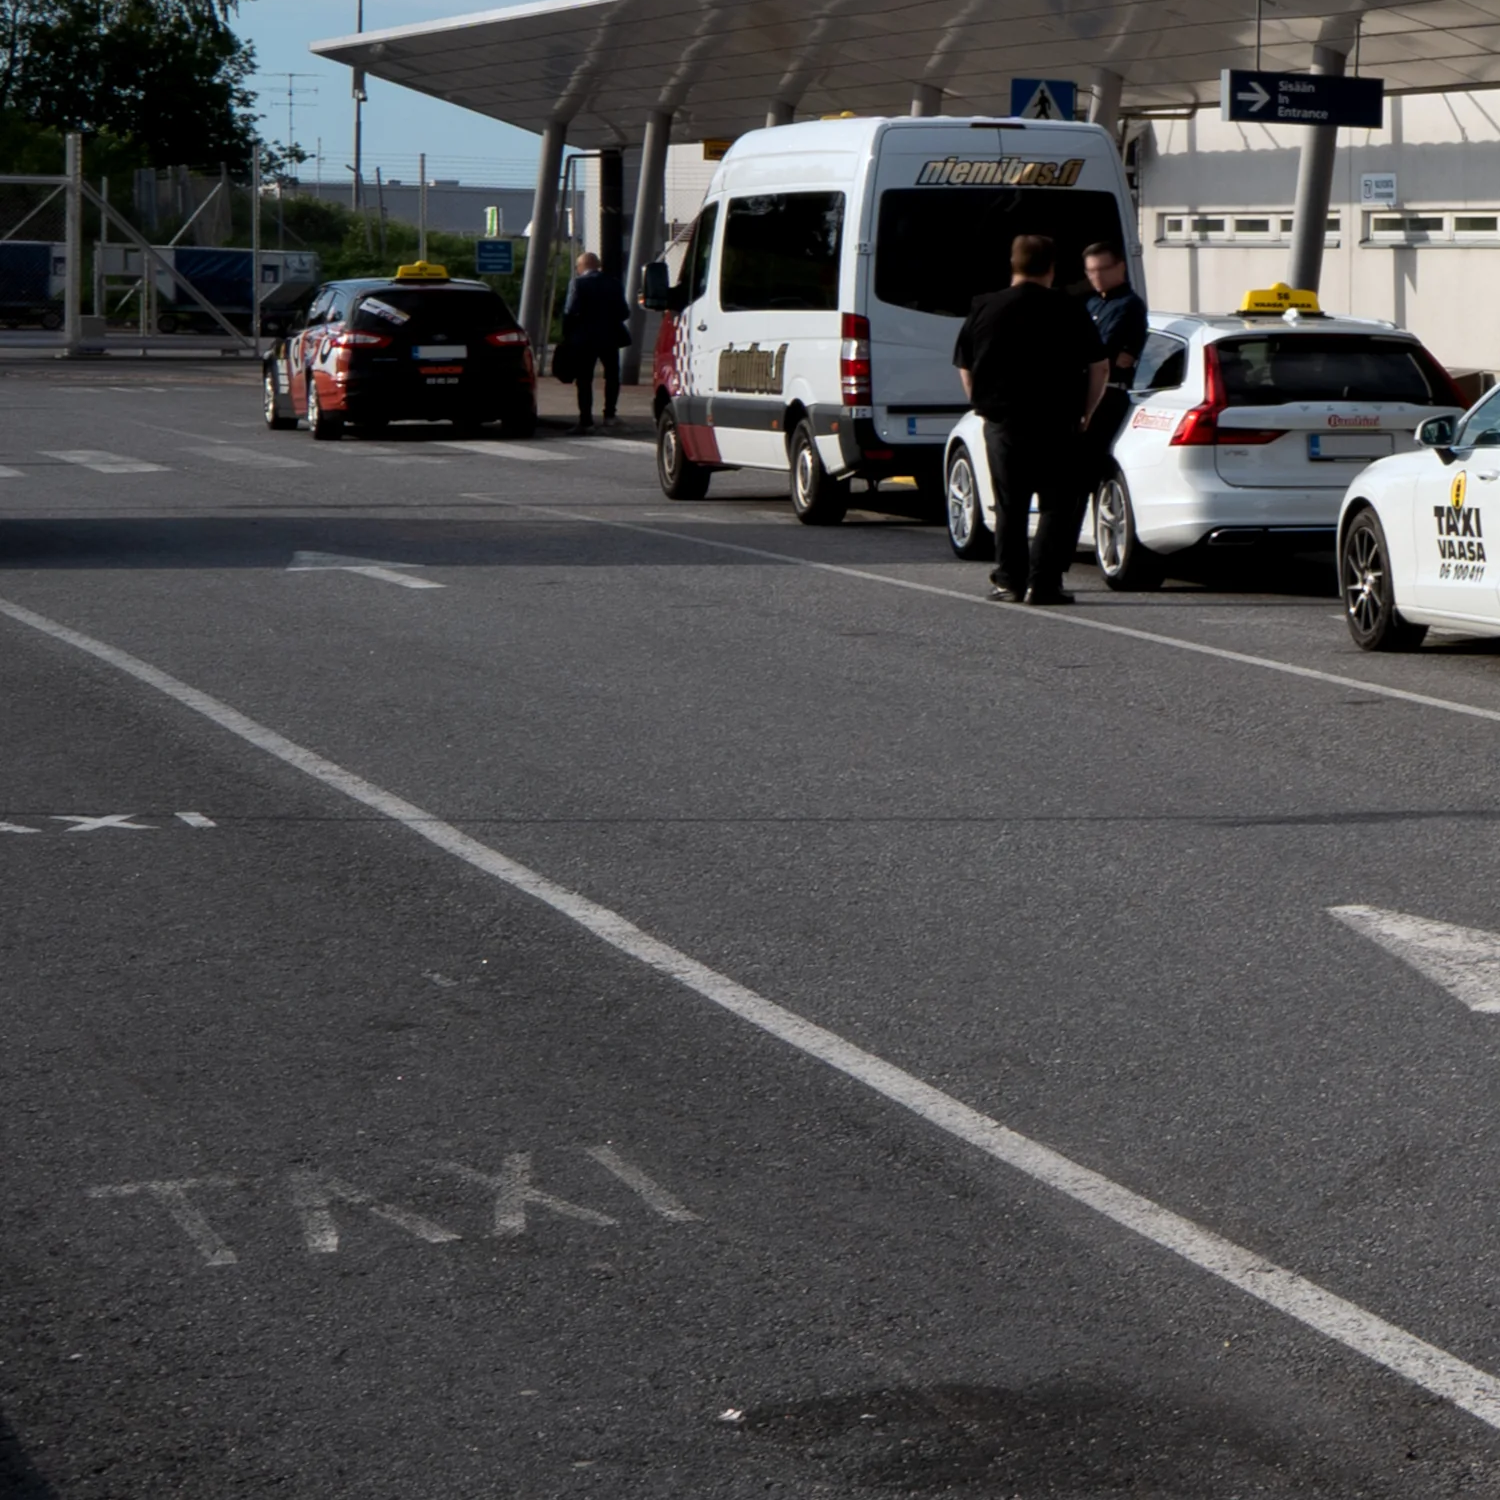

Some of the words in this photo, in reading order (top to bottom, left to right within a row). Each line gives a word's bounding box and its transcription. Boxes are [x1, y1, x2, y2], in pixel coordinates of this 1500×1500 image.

[1277, 93, 1290, 104] In
[1277, 106, 1329, 120] Entrance
[915, 155, 1086, 187] niemibus.fi
[1433, 505, 1483, 538] TAXI
[1437, 539, 1487, 563] VAASA
[1439, 563, 1452, 580] 06
